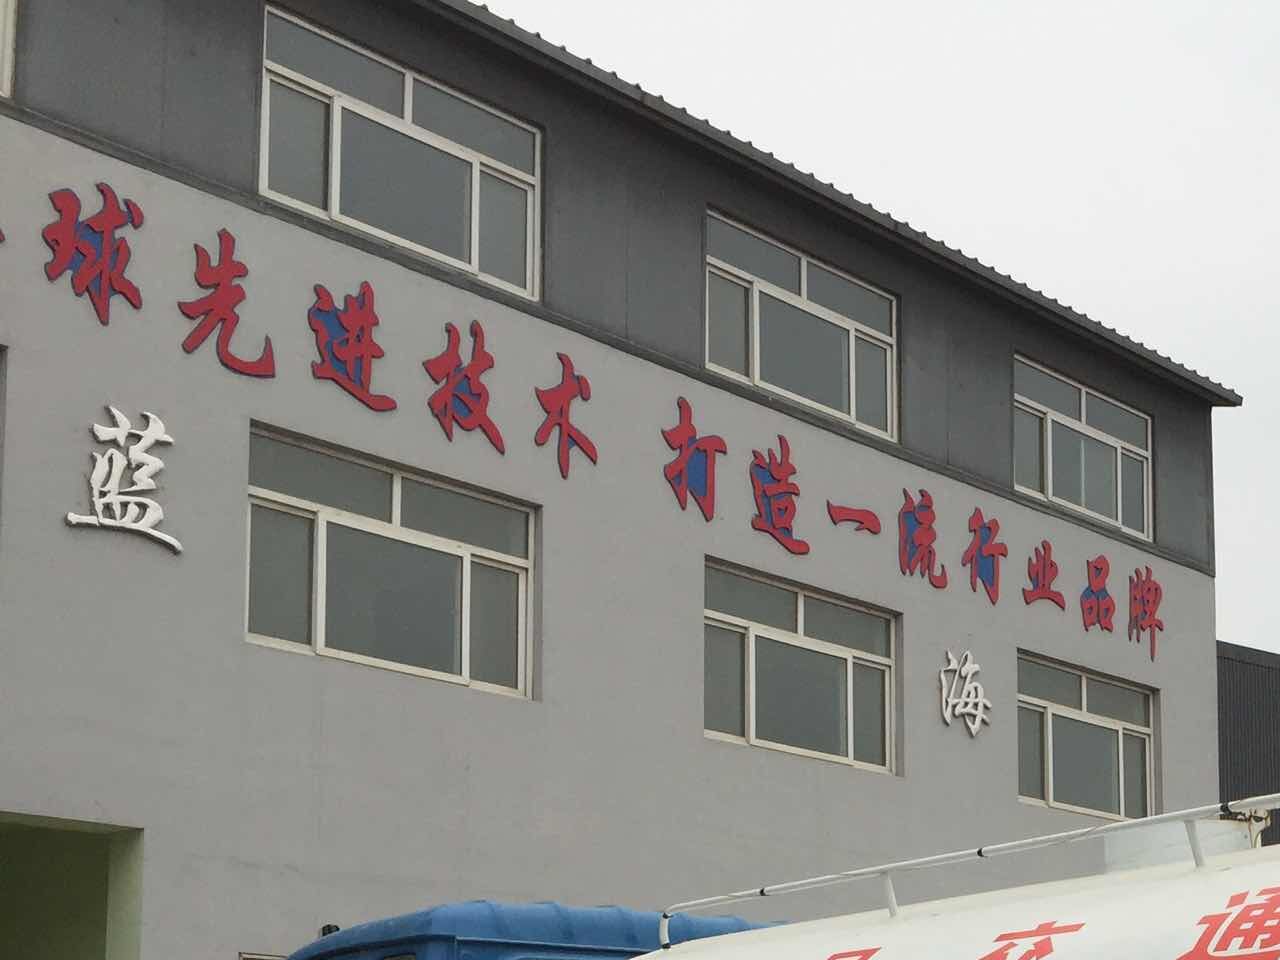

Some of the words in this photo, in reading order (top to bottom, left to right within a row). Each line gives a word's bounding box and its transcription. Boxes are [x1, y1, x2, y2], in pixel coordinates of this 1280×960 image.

[0, 183, 598, 479] 球先进技术
[940, 649, 993, 737] 海
